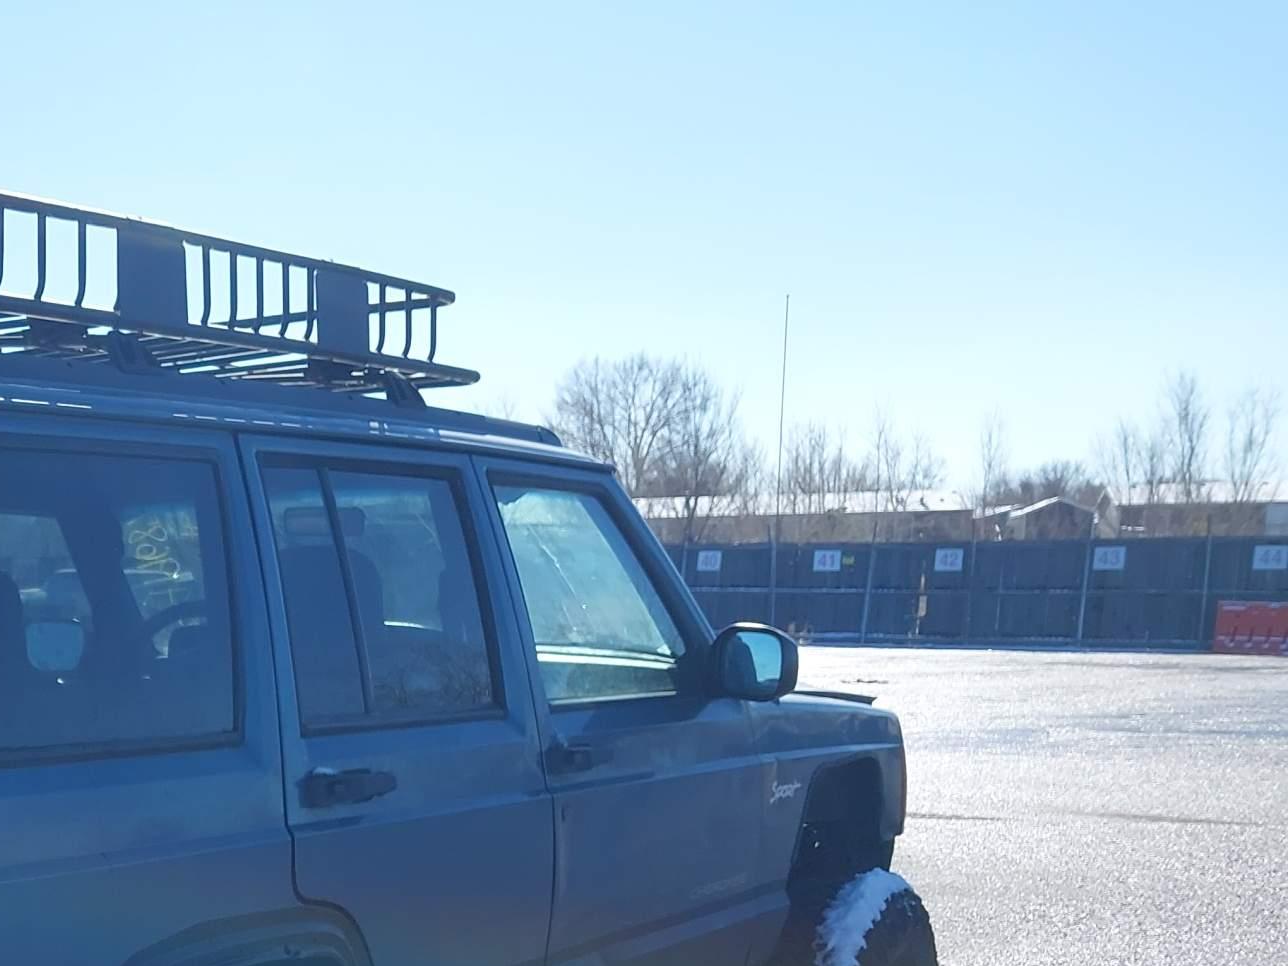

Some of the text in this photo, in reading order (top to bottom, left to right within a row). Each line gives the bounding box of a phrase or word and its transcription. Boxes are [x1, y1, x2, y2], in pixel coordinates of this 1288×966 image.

[817, 552, 837, 568] 41
[938, 552, 959, 568] 42
[1096, 550, 1121, 566] 43
[1258, 549, 1282, 567] 44
